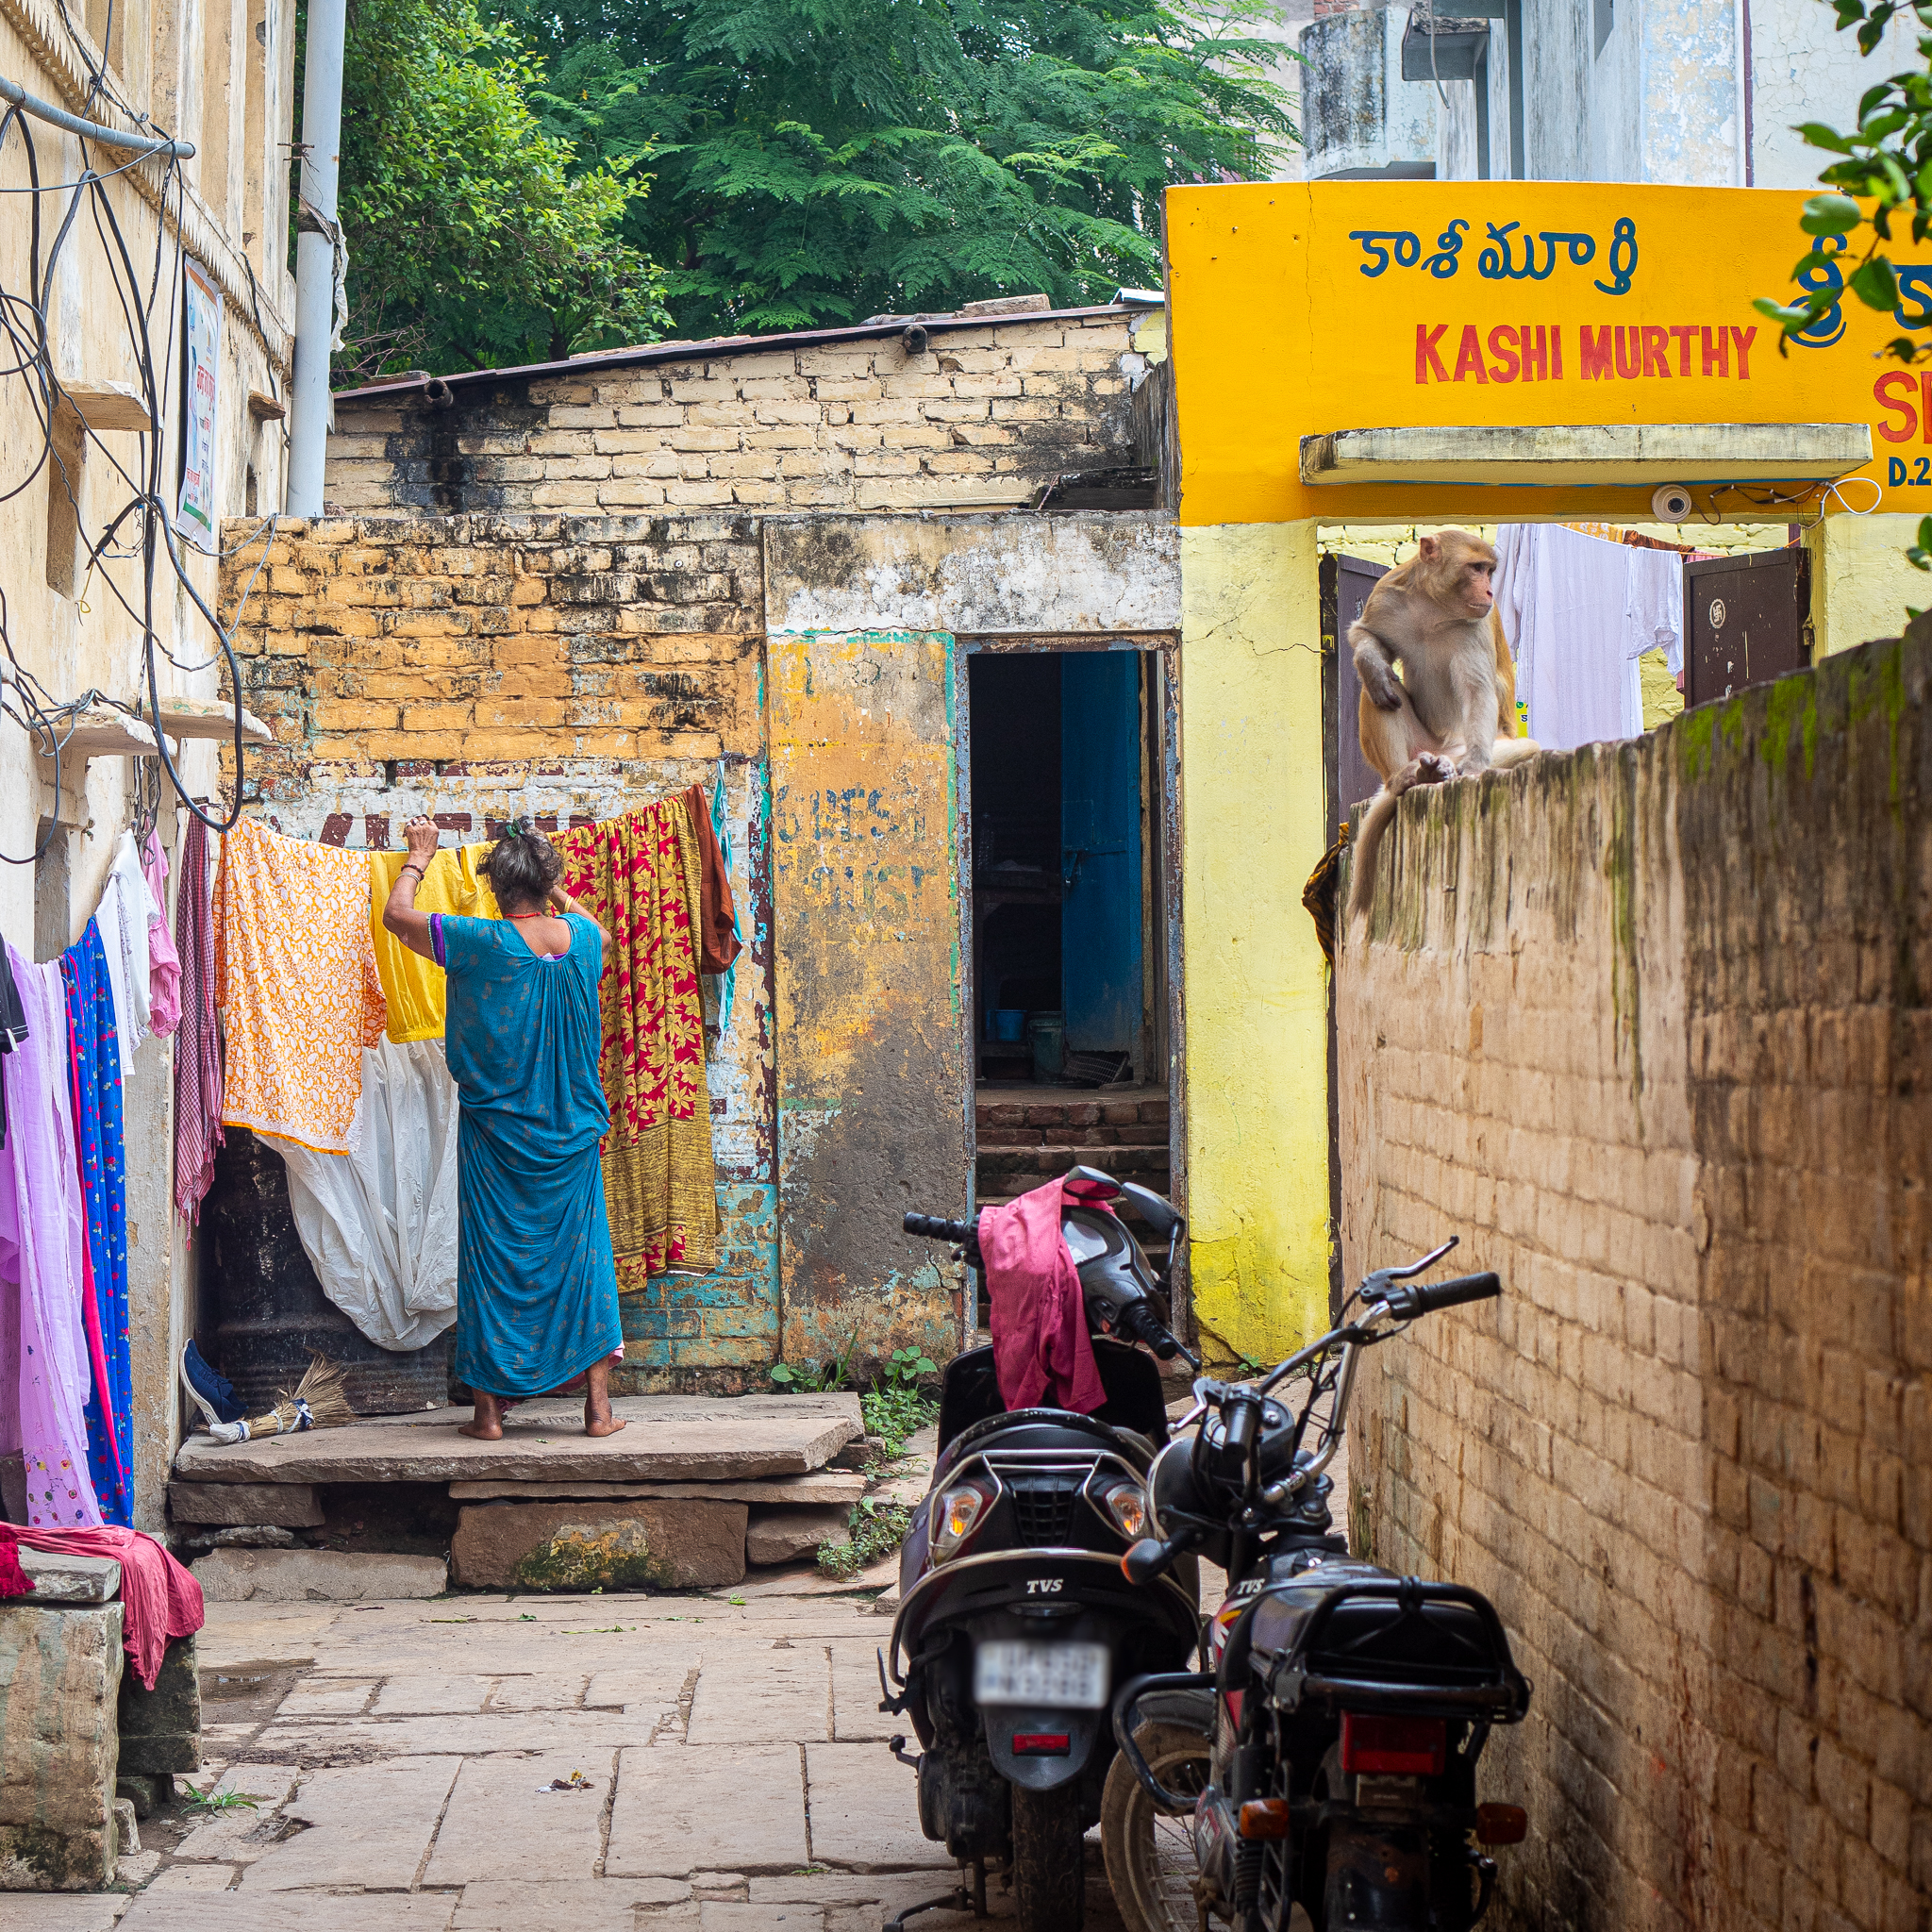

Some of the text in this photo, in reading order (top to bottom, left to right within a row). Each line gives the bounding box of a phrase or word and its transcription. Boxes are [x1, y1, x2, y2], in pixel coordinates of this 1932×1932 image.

[1415, 324, 1758, 385] KASHI MURTHY
[1026, 1578, 1064, 1594] TVS
[1237, 1577, 1265, 1595] TVS
